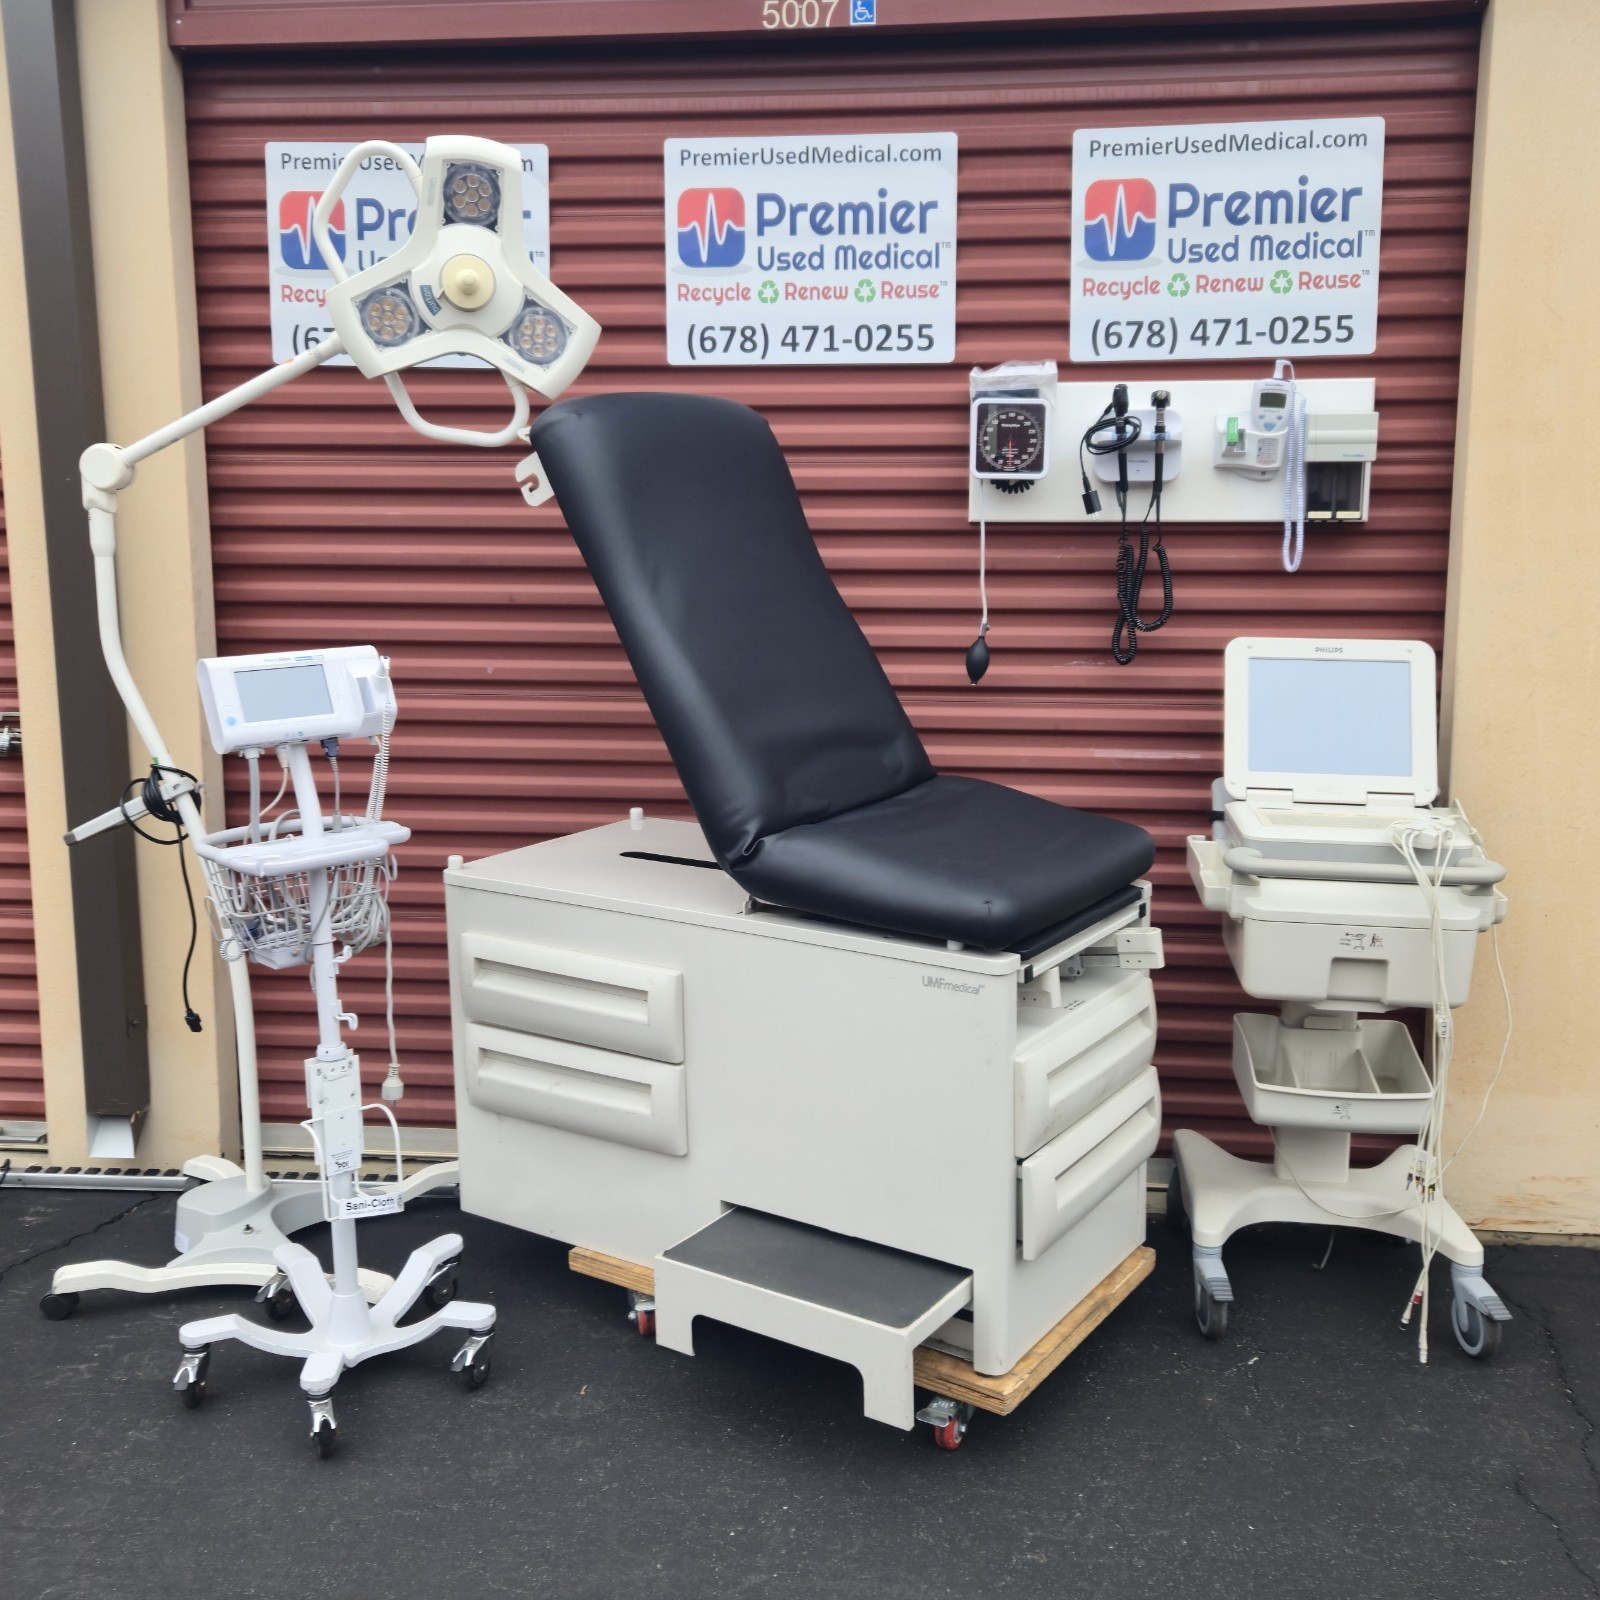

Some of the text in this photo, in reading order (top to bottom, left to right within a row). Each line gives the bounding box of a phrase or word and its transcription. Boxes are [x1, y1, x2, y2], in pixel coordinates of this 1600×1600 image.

[762, 0, 839, 28] 5007
[680, 144, 942, 167] PremierUsedMedical.com
[1089, 130, 1368, 158] PremierUsedMedical.com
[757, 187, 939, 236] Premier
[1168, 175, 1363, 228] Premier
[757, 244, 824, 271] Used
[1168, 235, 1239, 264] Used
[678, 282, 751, 306] Recycle
[785, 281, 848, 300] Renew
[1083, 275, 1161, 300] Recycle
[1196, 274, 1264, 293] Renew
[688, 323, 935, 360] (678) 471-0255
[1091, 314, 1354, 356] (678) 471-0255
[1314, 646, 1344, 654] PHILIPS
